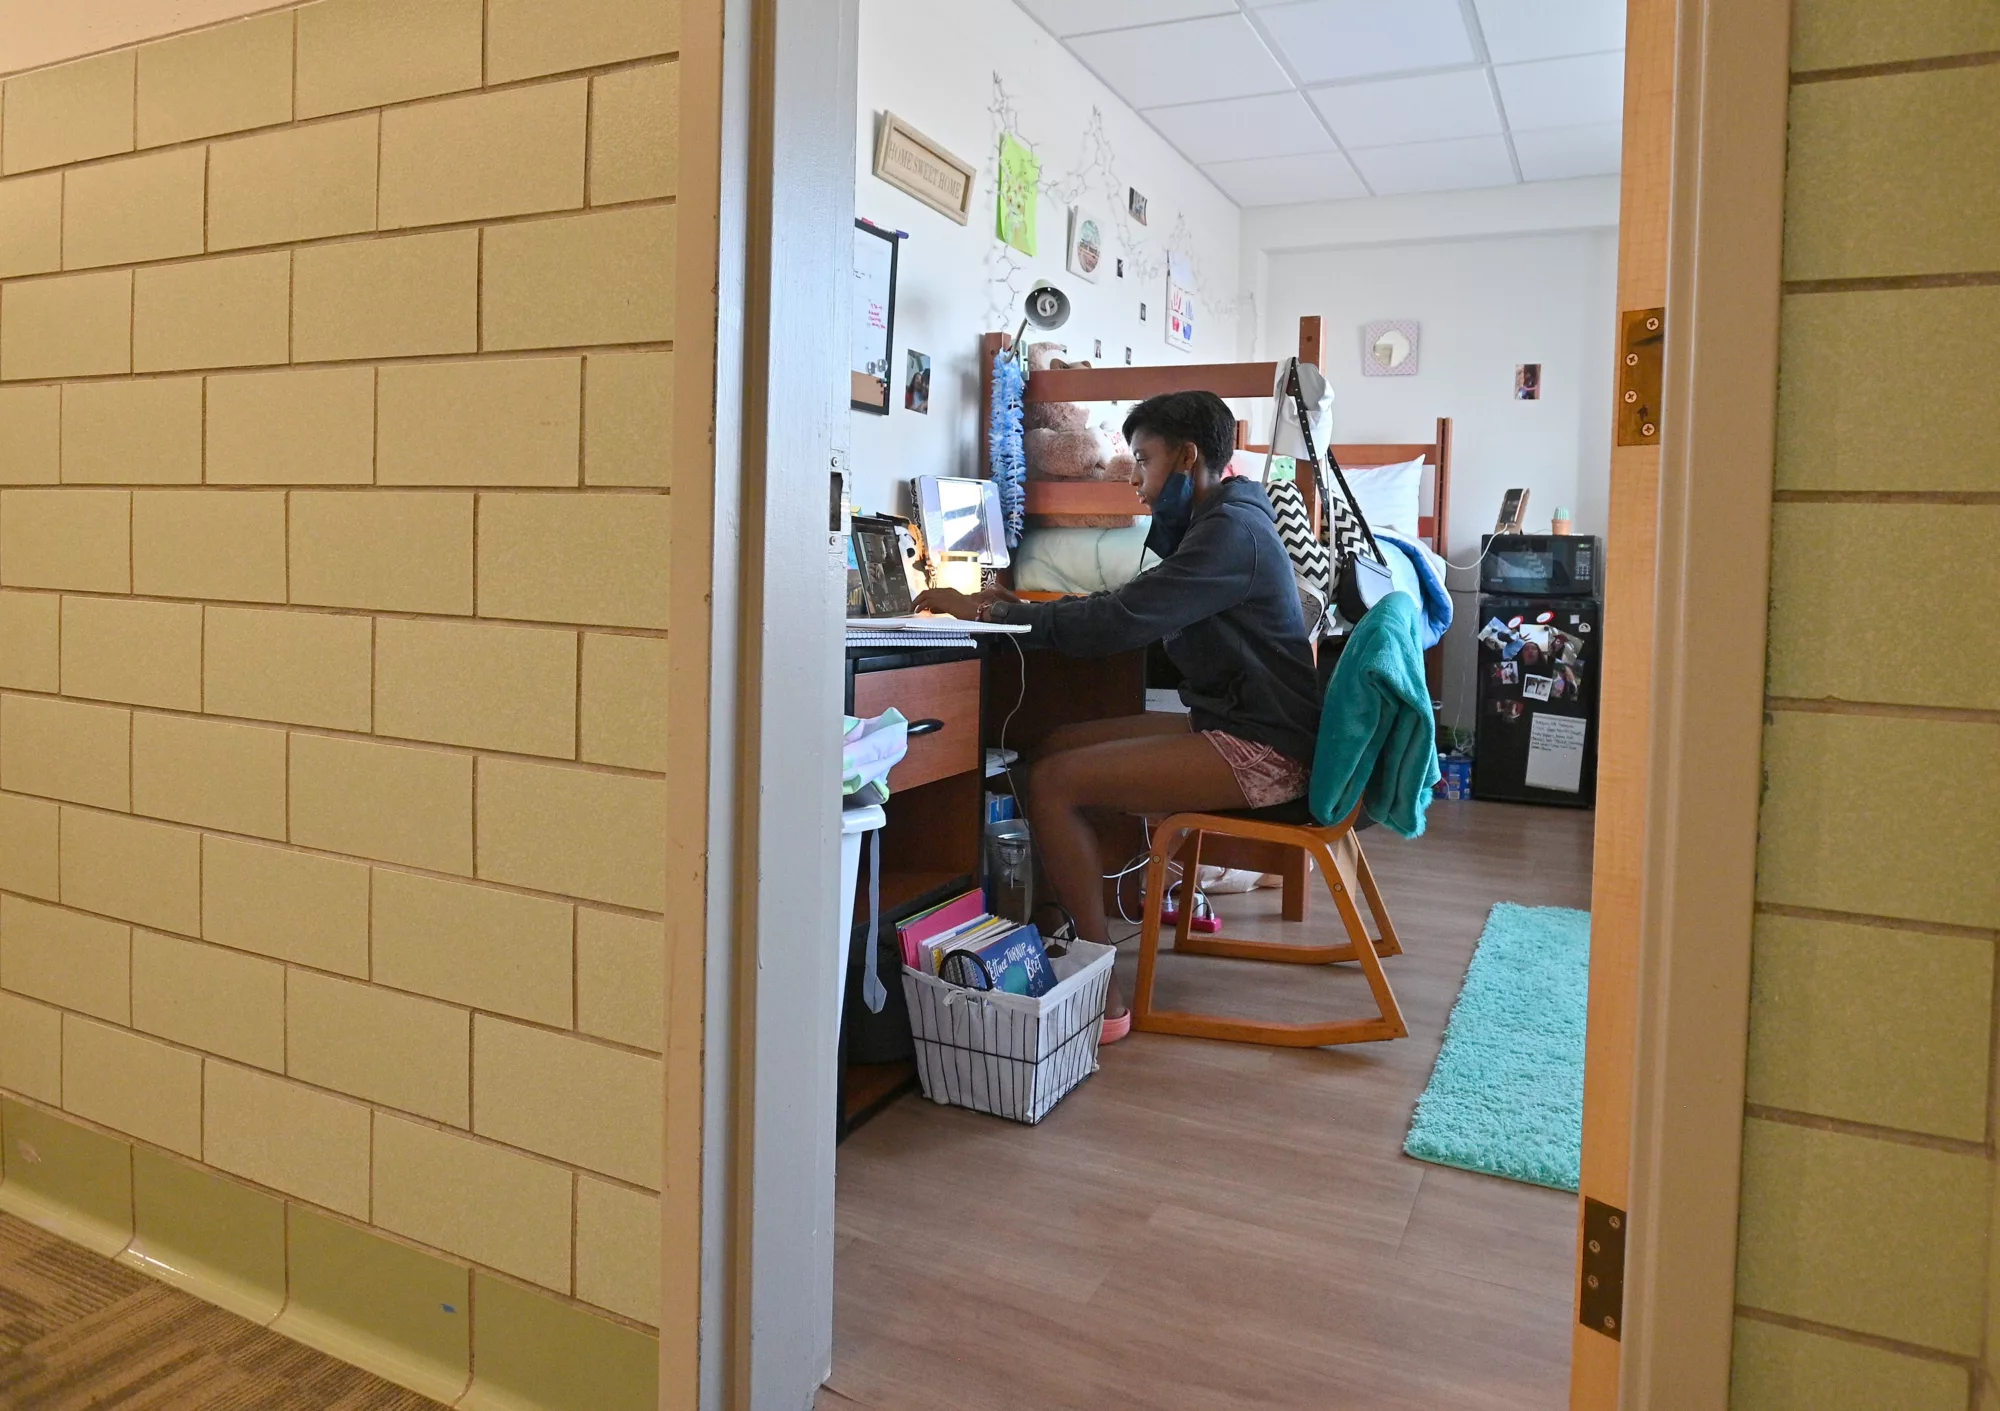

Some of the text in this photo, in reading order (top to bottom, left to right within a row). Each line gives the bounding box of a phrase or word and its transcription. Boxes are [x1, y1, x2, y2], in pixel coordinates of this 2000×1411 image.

[888, 142, 962, 199] HOME SWEET HOME
[1026, 943, 1036, 956] the
